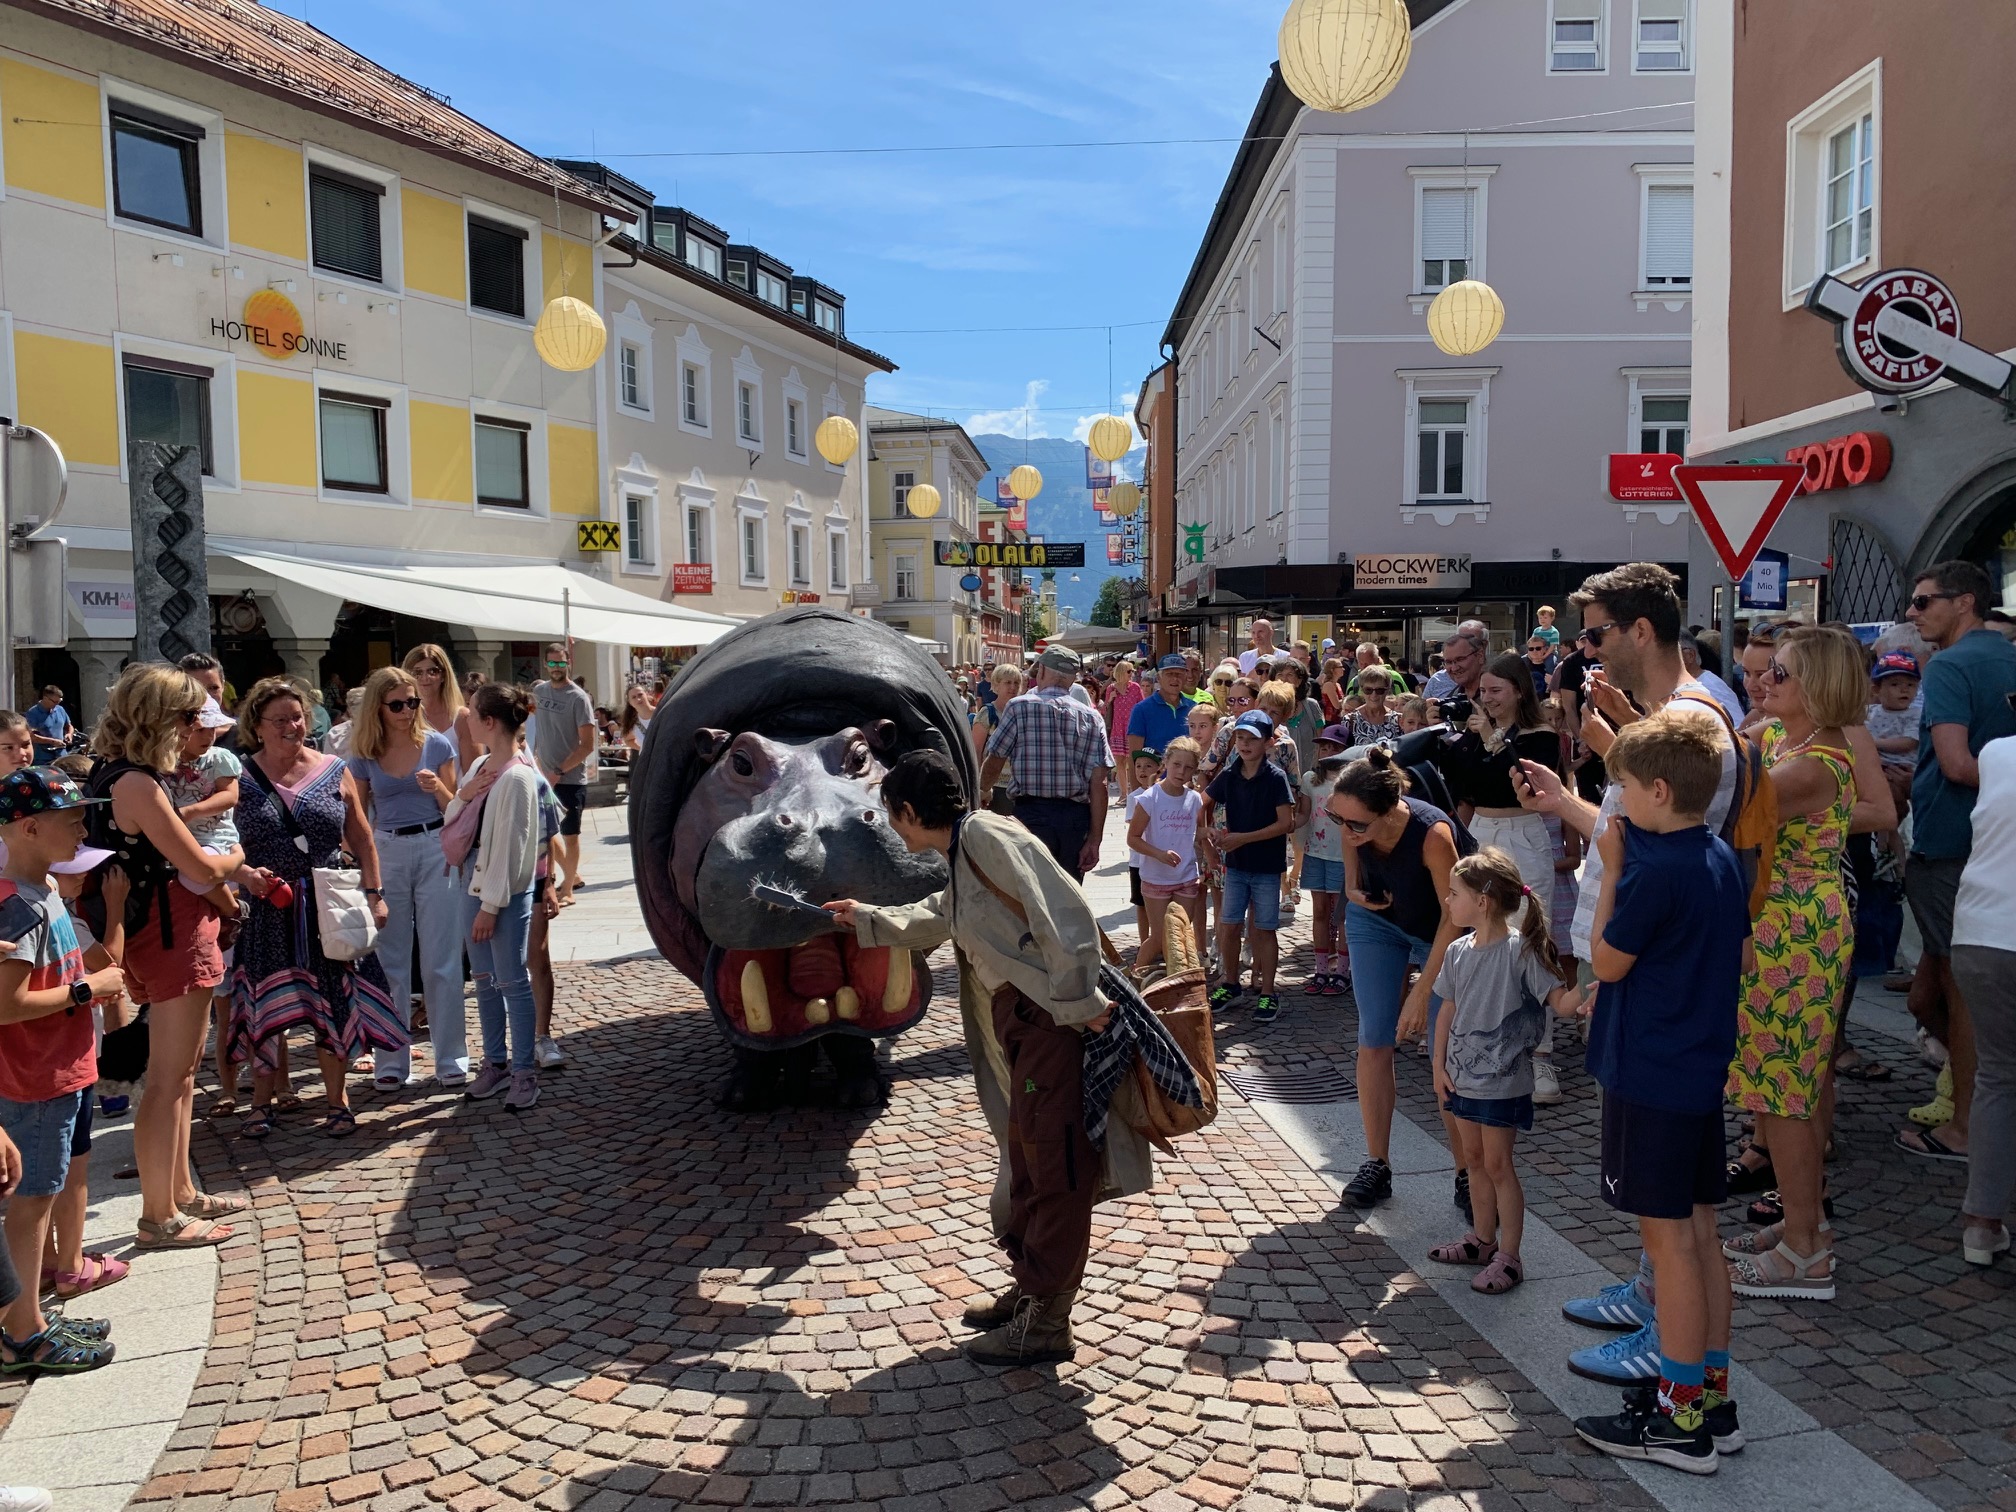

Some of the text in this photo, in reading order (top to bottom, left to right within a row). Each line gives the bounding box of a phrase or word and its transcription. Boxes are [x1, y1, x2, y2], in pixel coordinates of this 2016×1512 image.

[1874, 279, 1954, 325] TABAK
[210, 317, 347, 361] HOTEL SONNE
[1857, 320, 1930, 379] TRAFIK
[975, 545, 1046, 566] OLALA
[674, 566, 711, 575] KLEINE
[1356, 558, 1470, 574] KLOCKWERK
[1760, 568, 1772, 576] 40
[674, 575, 711, 585] ZEITUNG
[1356, 574, 1428, 585] modern times
[1757, 582, 1775, 591] Mio.
